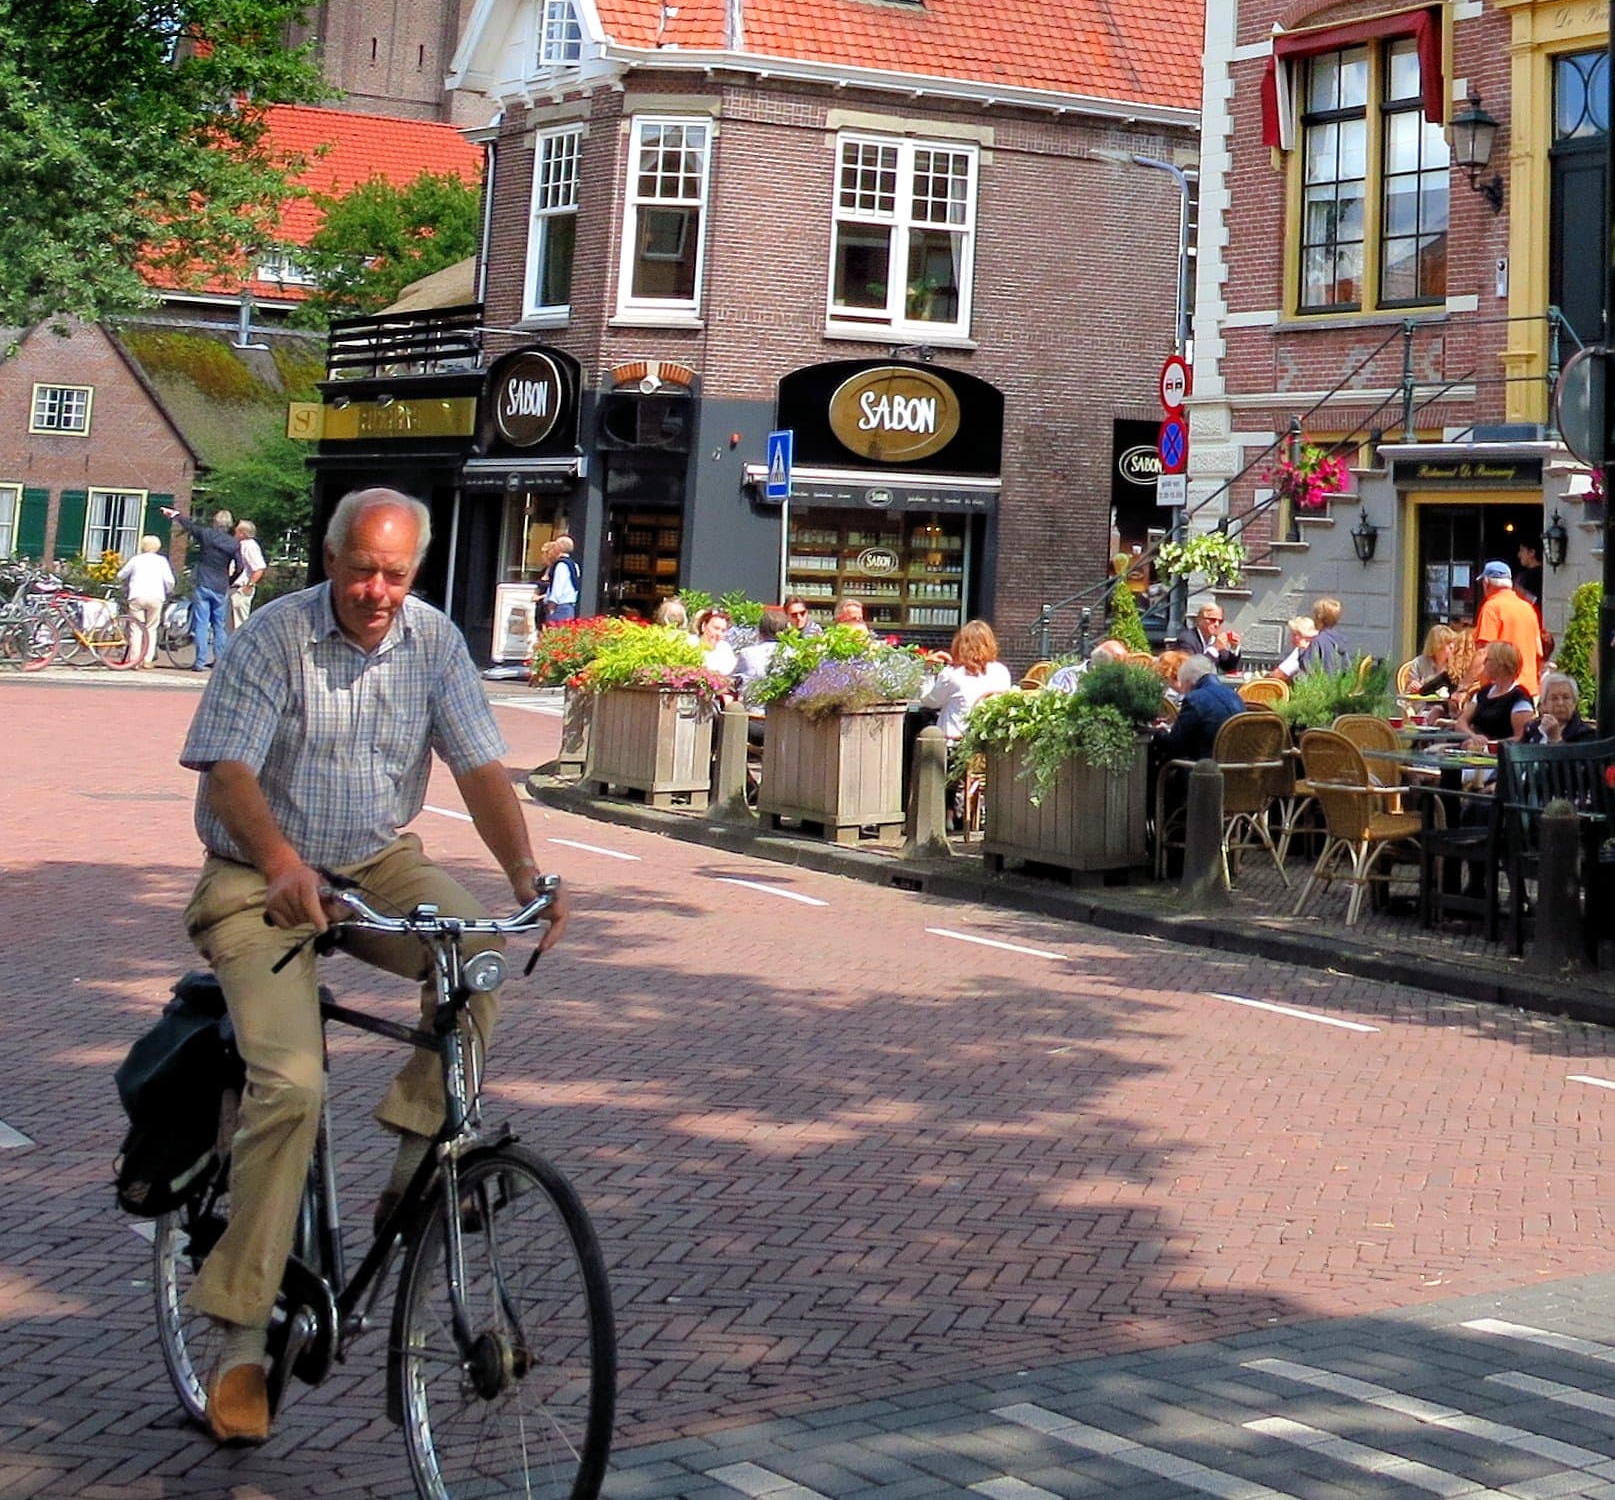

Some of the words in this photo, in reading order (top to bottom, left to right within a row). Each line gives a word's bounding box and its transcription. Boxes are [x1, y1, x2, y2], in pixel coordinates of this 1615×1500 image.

[506, 378, 549, 417] SABON
[858, 391, 936, 434] SABON
[1131, 455, 1162, 473] SABON
[866, 554, 891, 567] SABON
